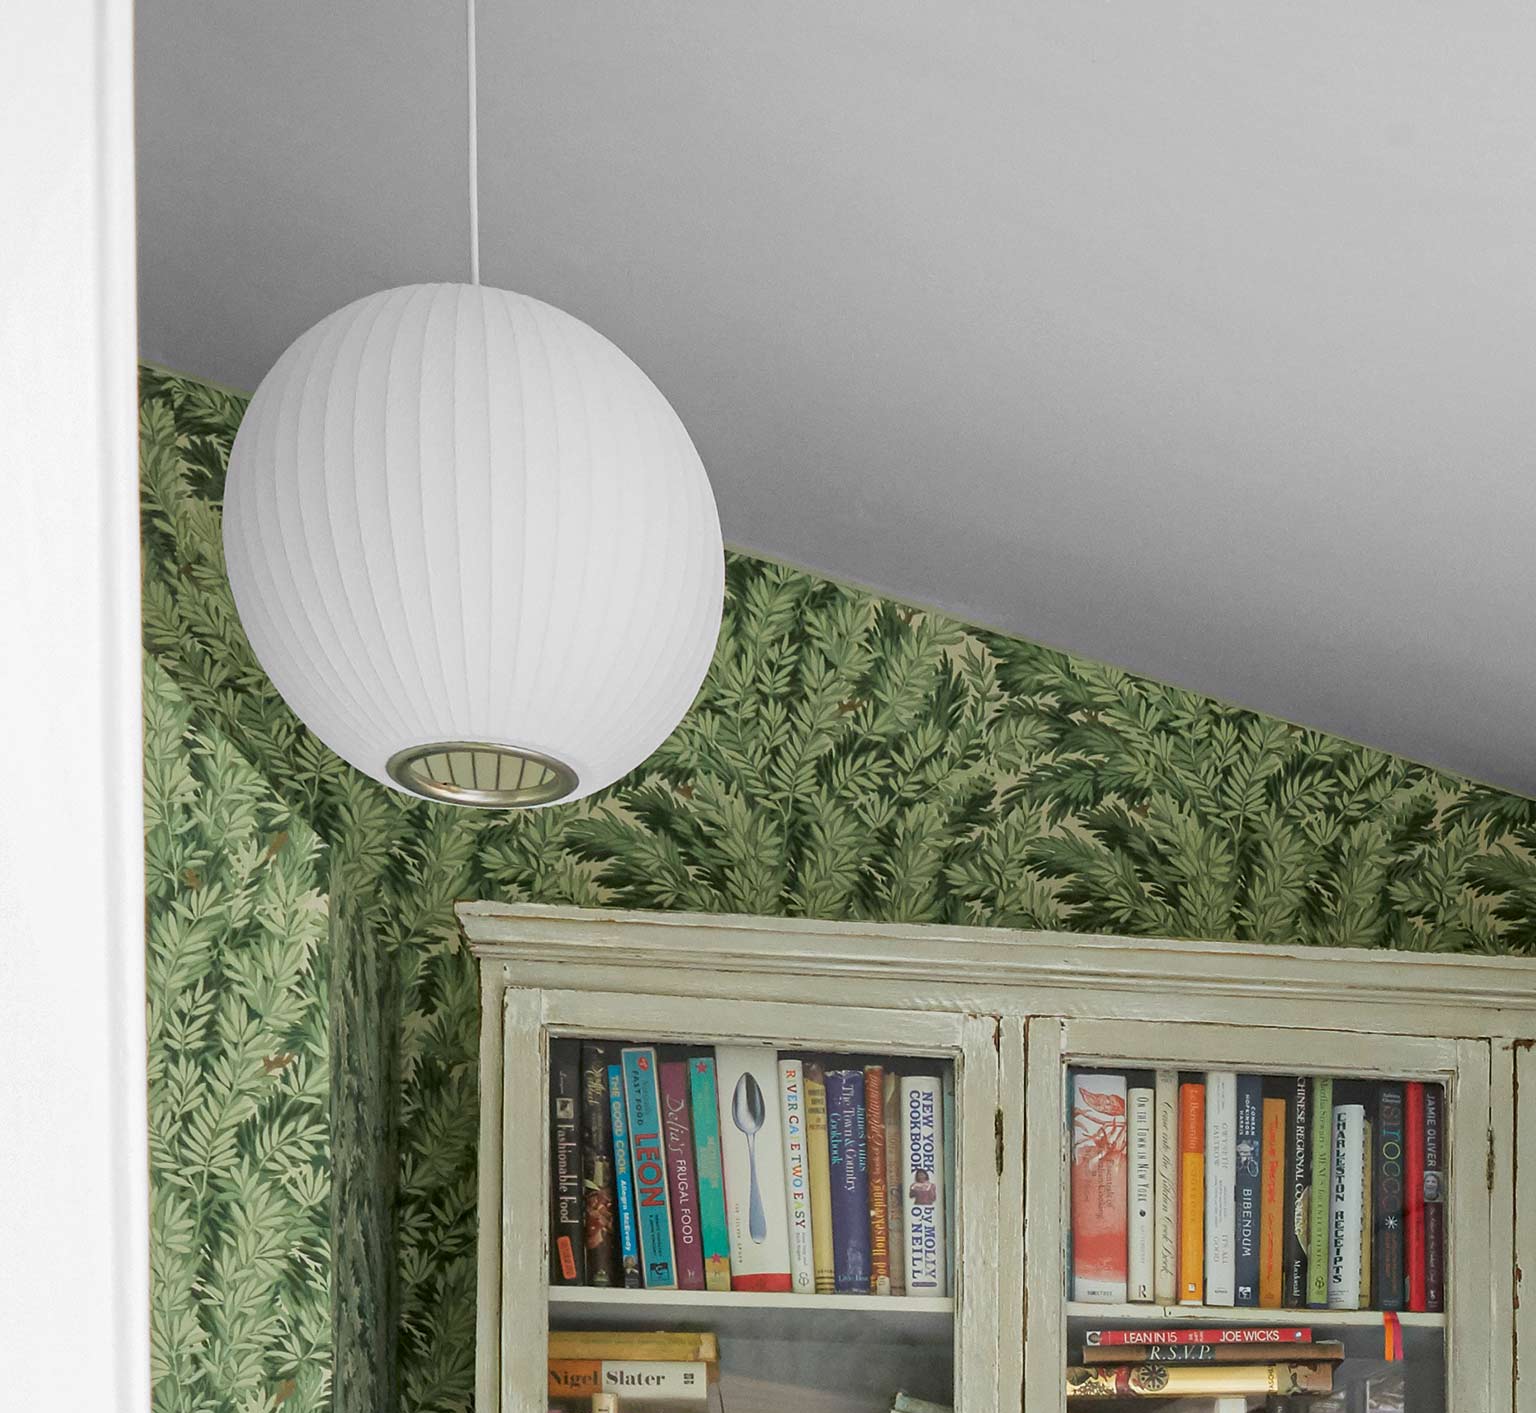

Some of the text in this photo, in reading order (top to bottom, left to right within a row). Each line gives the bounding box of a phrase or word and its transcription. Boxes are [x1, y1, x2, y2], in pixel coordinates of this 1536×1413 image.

[632, 1070, 644, 1126] FAST FOOD
[909, 1090, 922, 1174] COOKBOOK
[922, 1091, 935, 1175] NEW YORK
[1426, 1093, 1436, 1167] JAMIE OLIVER
[557, 1124, 580, 1224] Fashionable Food
[611, 1075, 630, 1210] THE GOOD COOK Allegra
[634, 1133, 665, 1207] LEON
[666, 1094, 693, 1244] Delia's FRUGAL FOOD
[786, 1070, 806, 1229] RIVER TWO EASY
[830, 1112, 843, 1165] Cookbook
[840, 1084, 857, 1192] The Town & Country
[1137, 1127, 1150, 1202] TOWN NEW YORK
[1293, 1077, 1306, 1235] CHINESE REGIONAL COOKING
[1158, 1102, 1174, 1273] Come the Kitchen Cook Book
[1242, 1188, 1253, 1256] BIBENDUM
[1333, 1112, 1347, 1284] CHARLESTON RECEIPTS
[910, 1206, 923, 1279] O'NEILL
[922, 1206, 937, 1279] by MOLLY
[1292, 1260, 1302, 1297] Macdonald
[1123, 1331, 1281, 1344] LEAN IN 15 JOE WICKS
[1150, 1345, 1213, 1361] R.S.V.P.
[549, 1370, 666, 1388] Nigel Slater
